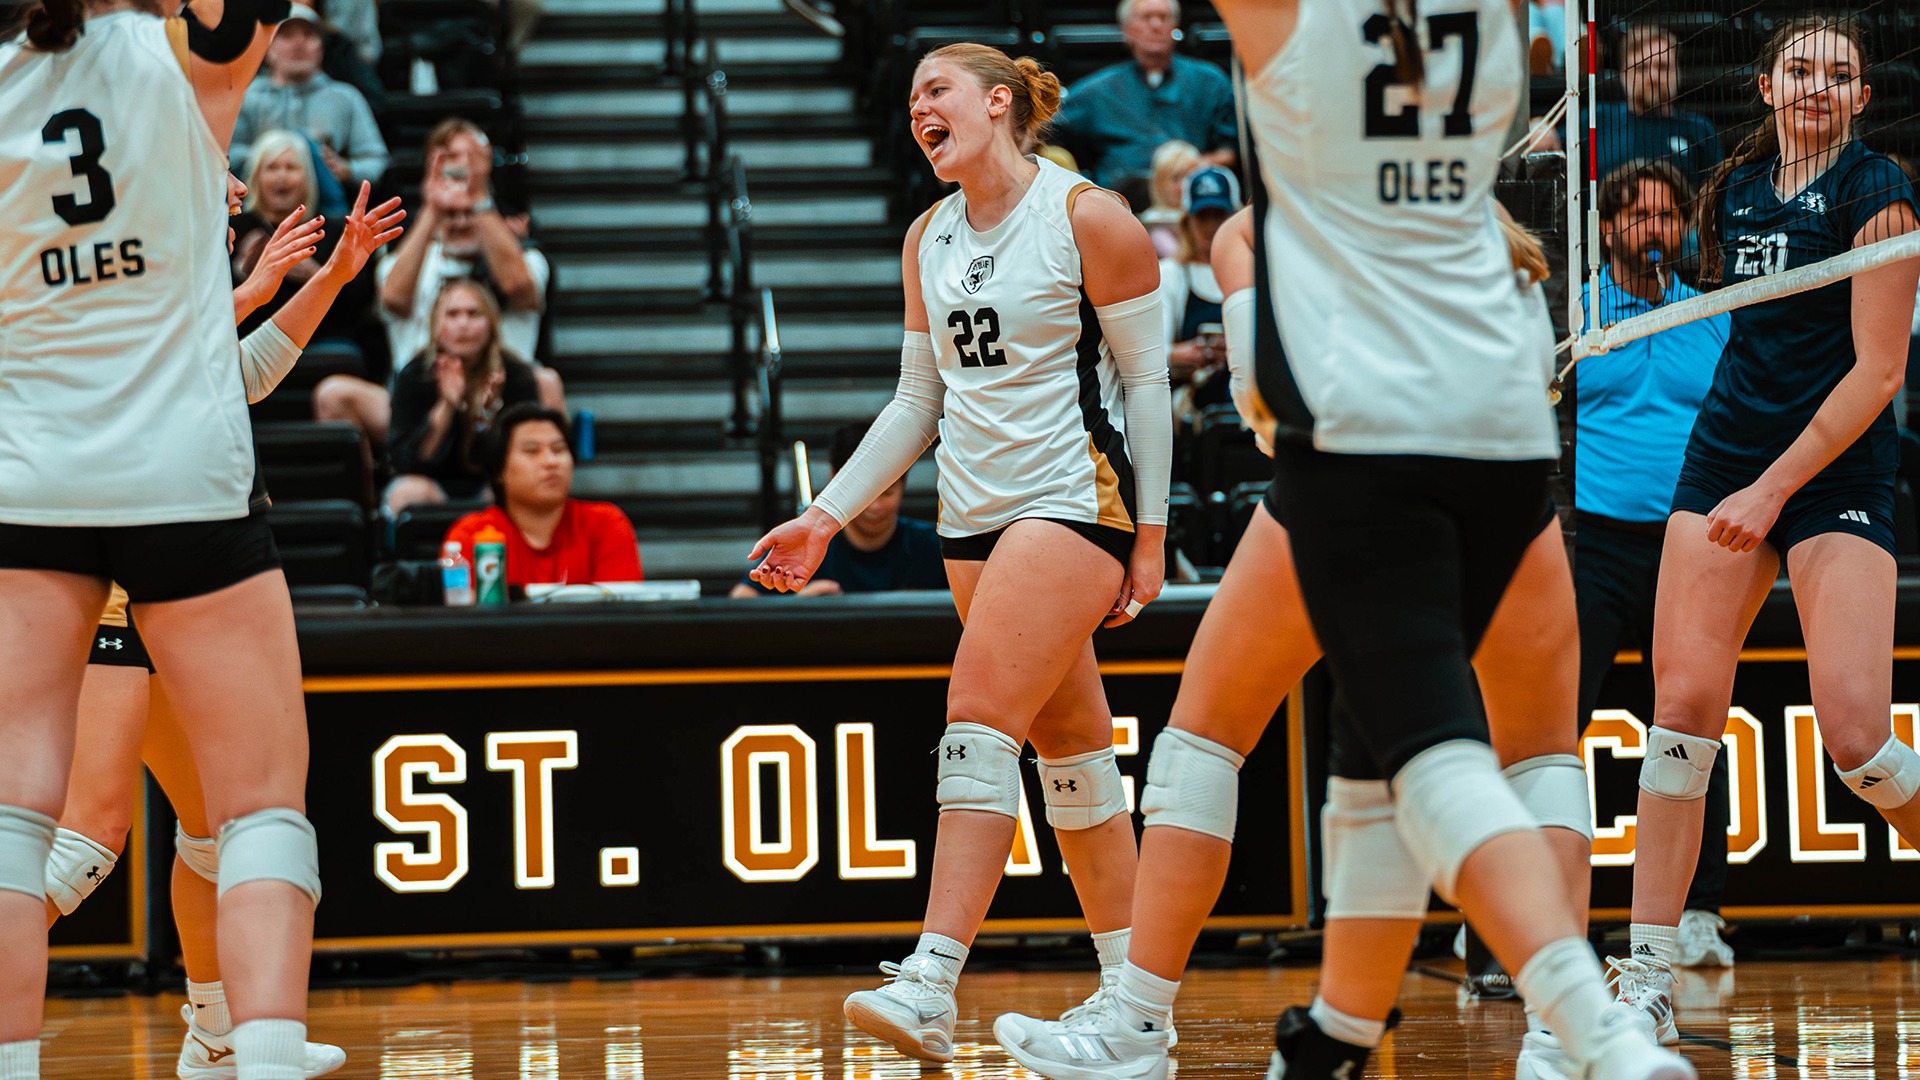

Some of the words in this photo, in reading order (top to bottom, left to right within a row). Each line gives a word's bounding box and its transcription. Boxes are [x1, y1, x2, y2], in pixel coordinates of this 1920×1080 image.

[1363, 11, 1479, 137] 27
[41, 107, 116, 227] 3
[1379, 160, 1466, 204] OLES
[40, 238, 146, 287] OLES
[1734, 231, 1789, 276] 20
[947, 306, 1008, 368] 22
[372, 729, 640, 894] ST.
[719, 716, 1139, 883] OL
